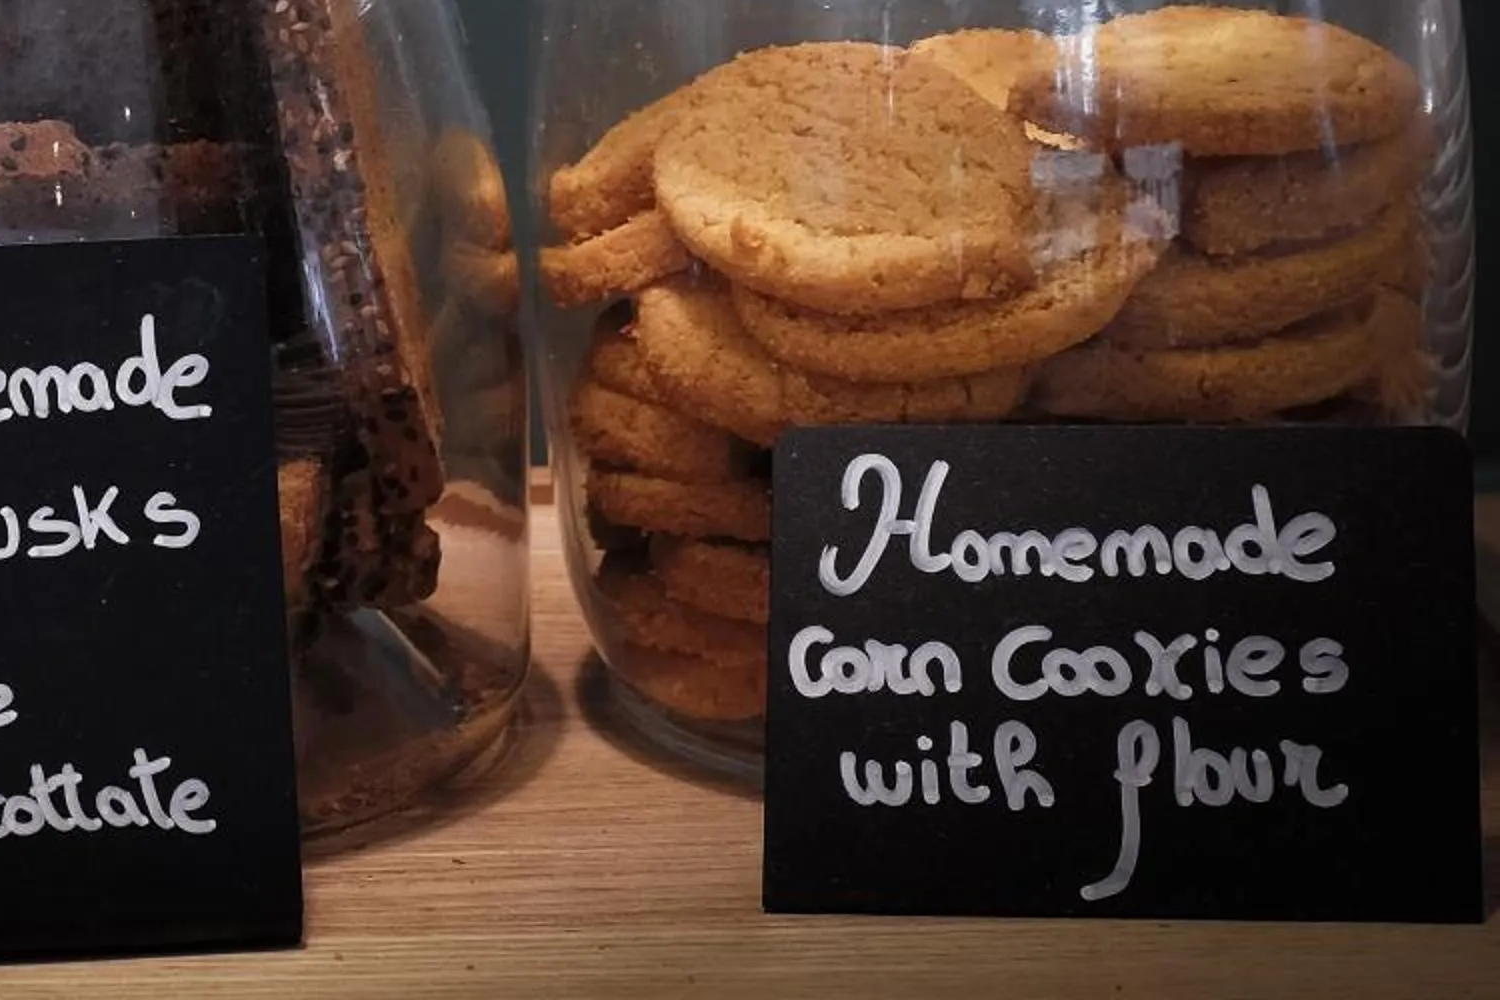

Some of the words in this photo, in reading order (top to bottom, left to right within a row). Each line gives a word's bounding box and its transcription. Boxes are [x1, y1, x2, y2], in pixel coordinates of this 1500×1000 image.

[818, 453, 1336, 596] Homemade
[788, 625, 962, 698] Corn
[991, 624, 1350, 701] Cookies
[839, 719, 1055, 812] with
[1080, 715, 1349, 901] flour
